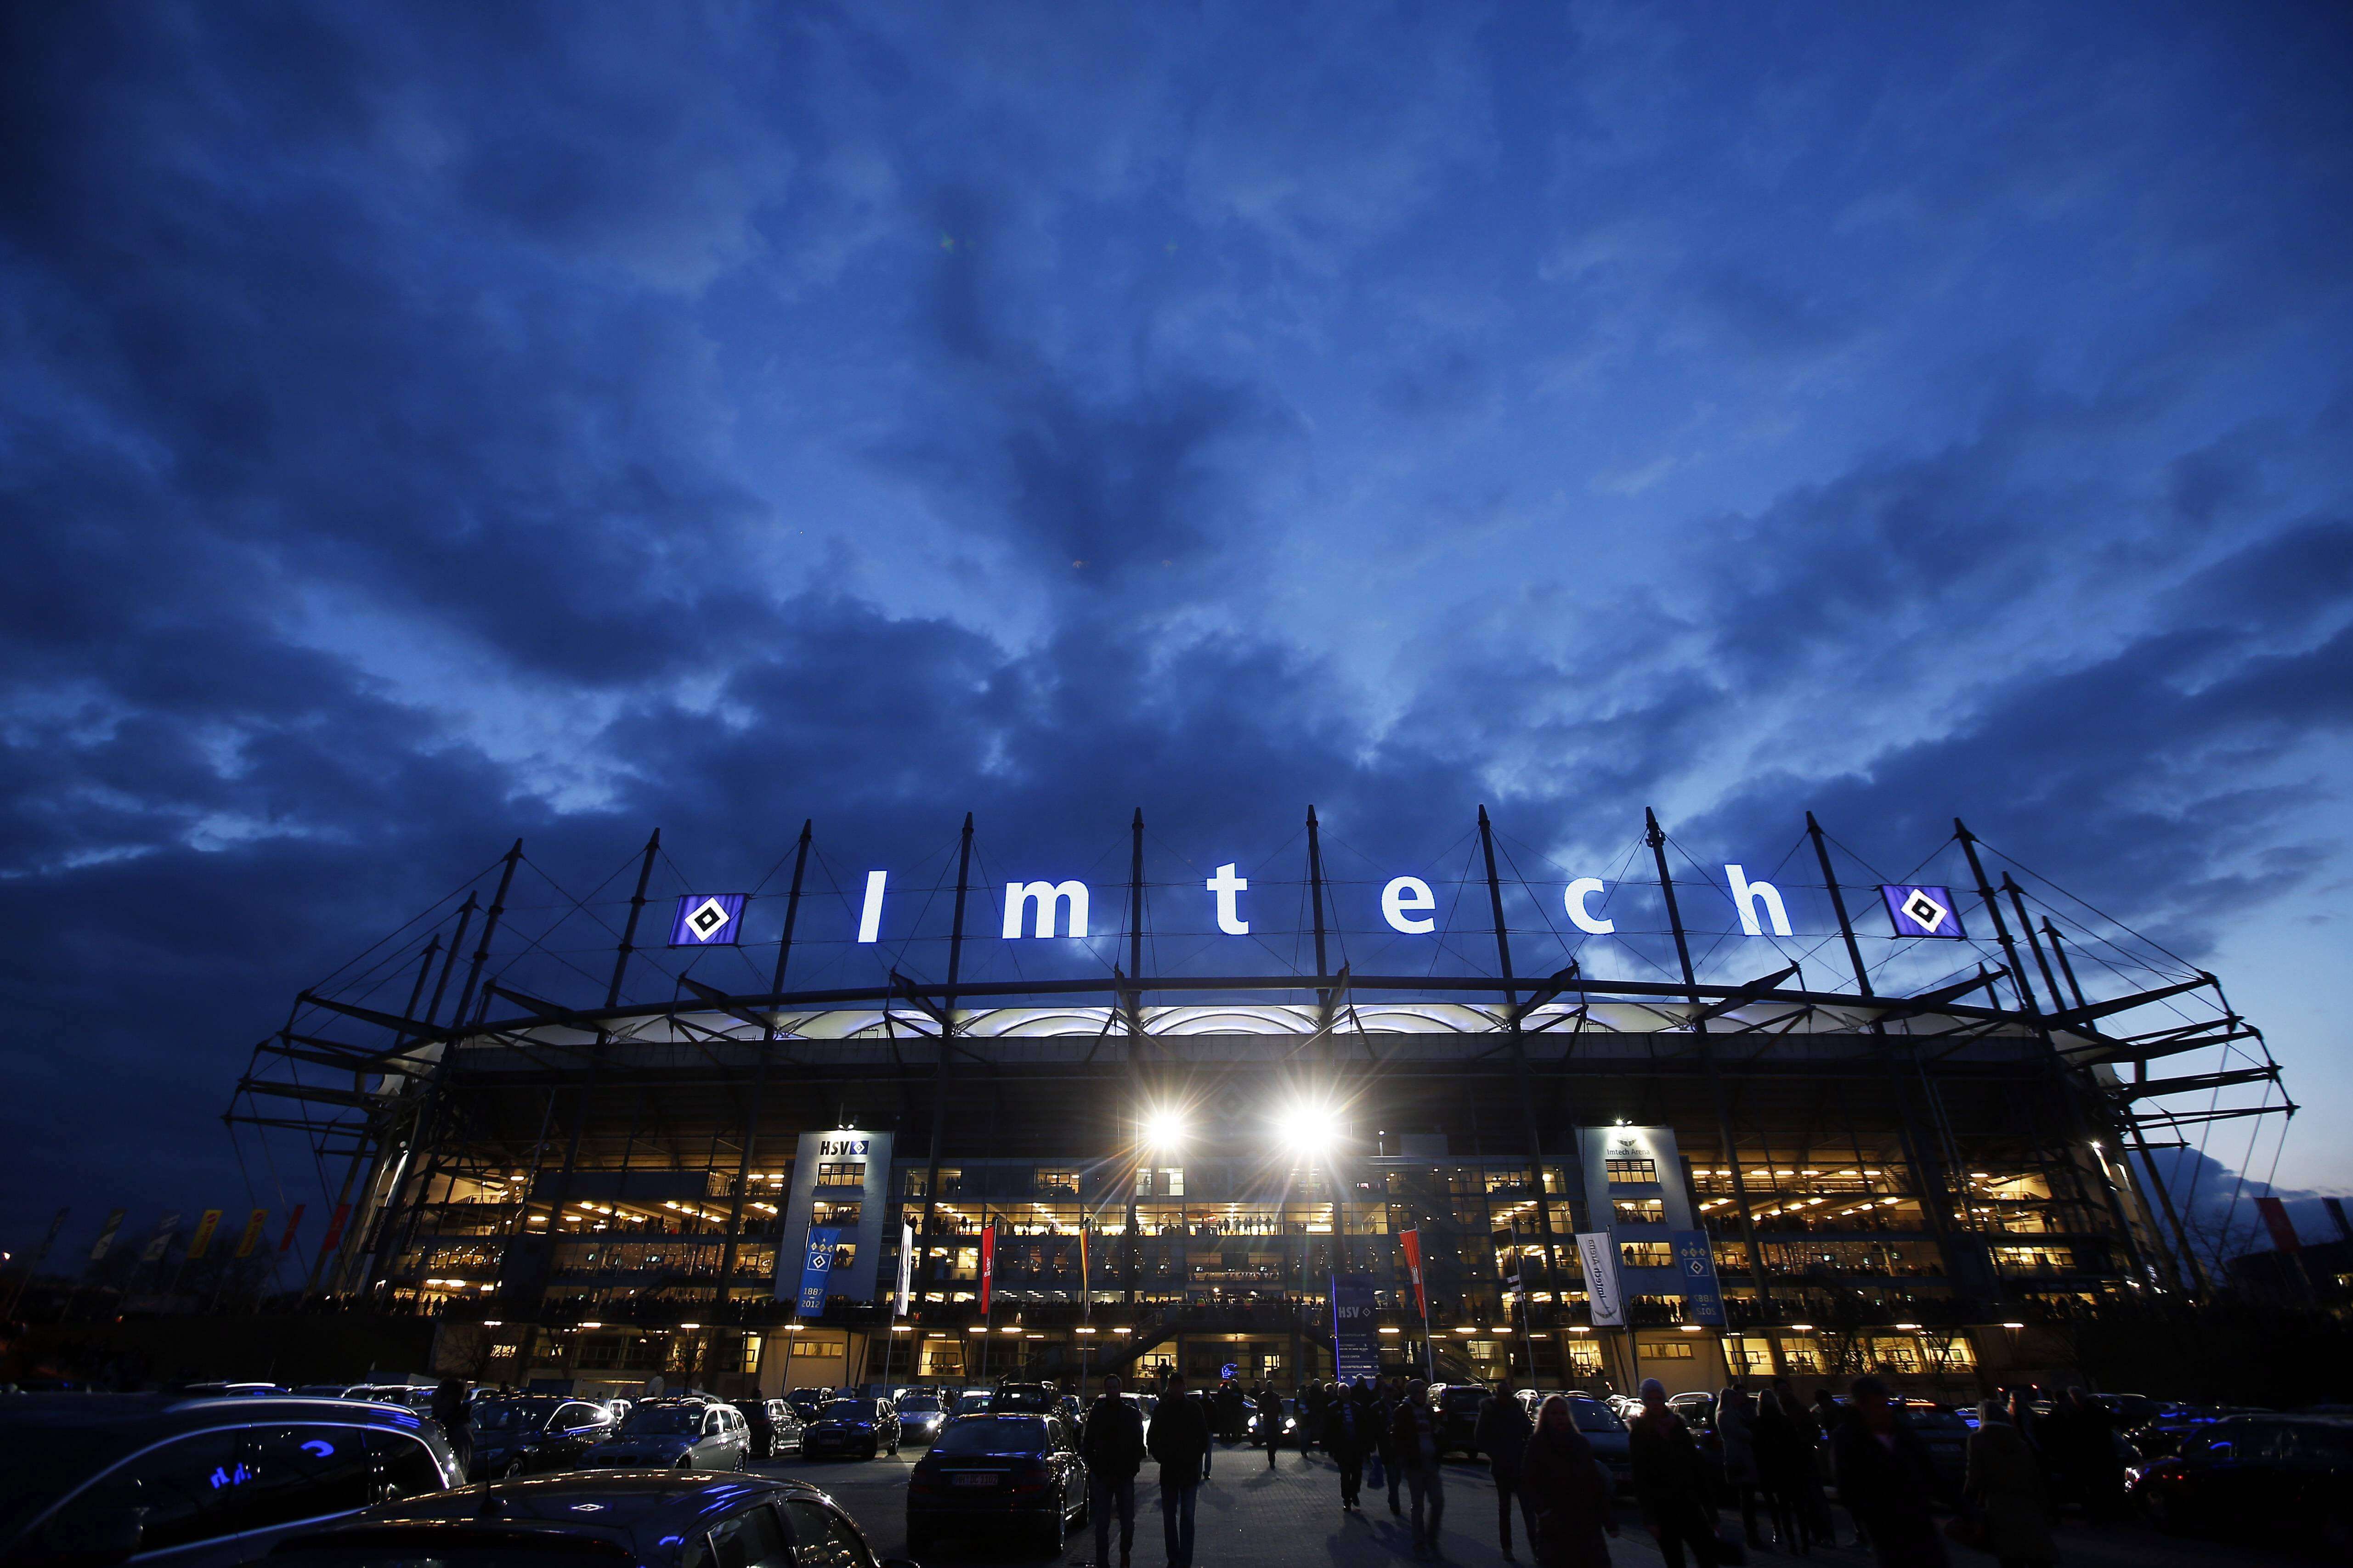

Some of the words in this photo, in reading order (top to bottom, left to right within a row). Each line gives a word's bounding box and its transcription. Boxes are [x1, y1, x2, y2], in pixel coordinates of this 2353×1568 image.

[858, 862, 1793, 942] Imtech
[820, 1141, 849, 1155] HSV
[1338, 1307, 1359, 1318] HSV
